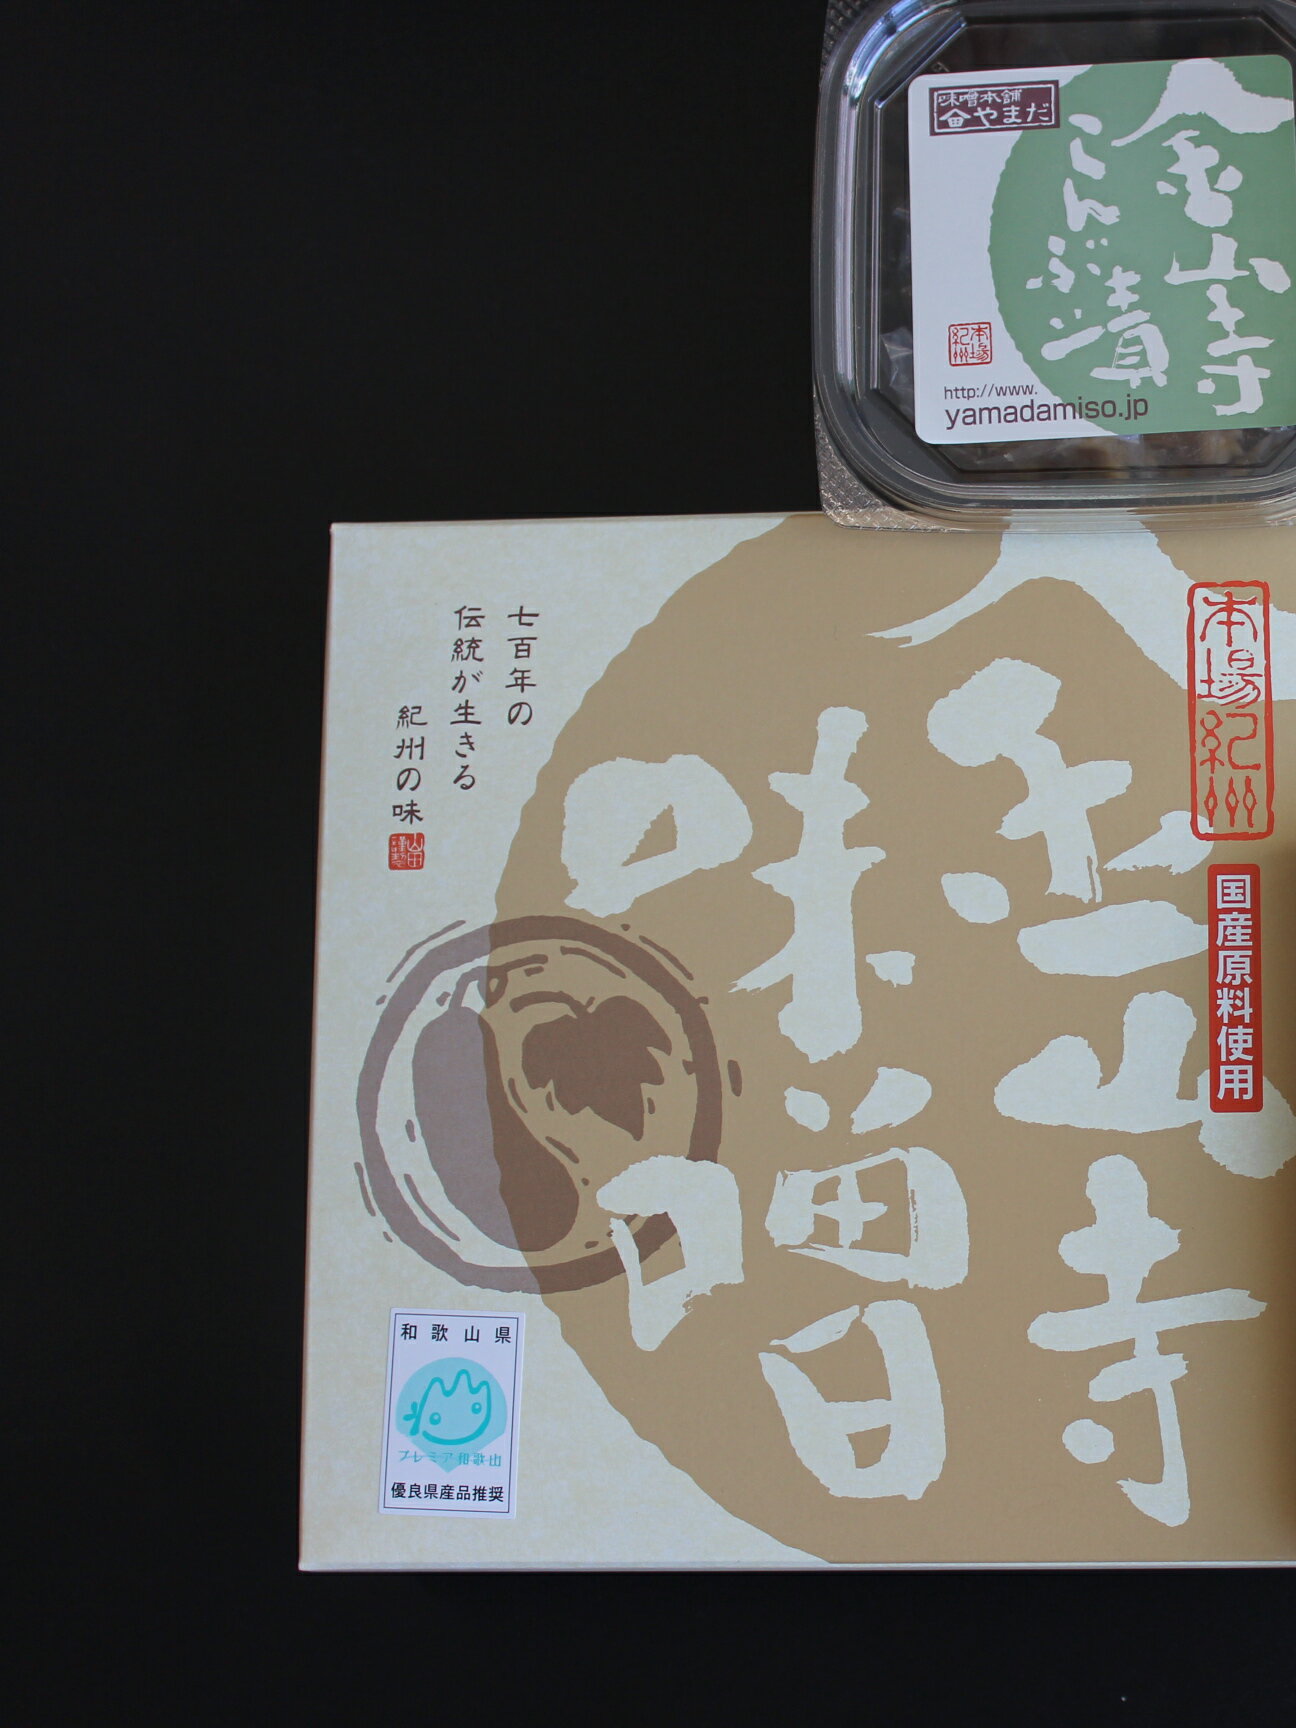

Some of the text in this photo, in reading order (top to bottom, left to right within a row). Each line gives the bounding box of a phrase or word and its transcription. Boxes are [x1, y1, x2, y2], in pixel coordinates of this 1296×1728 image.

[973, 102, 1050, 128] やまだ
[944, 384, 1038, 400] http://www.
[945, 393, 1150, 430] yamadamiso.jp
[505, 605, 540, 726] 七百年の
[449, 605, 486, 791] 伝統が生きる
[391, 704, 428, 825] 紀州の味
[1215, 873, 1255, 1102] 国産原料使用
[400, 1323, 512, 1344] 和歌山県
[391, 1482, 505, 1502] 優良県産品推奨
